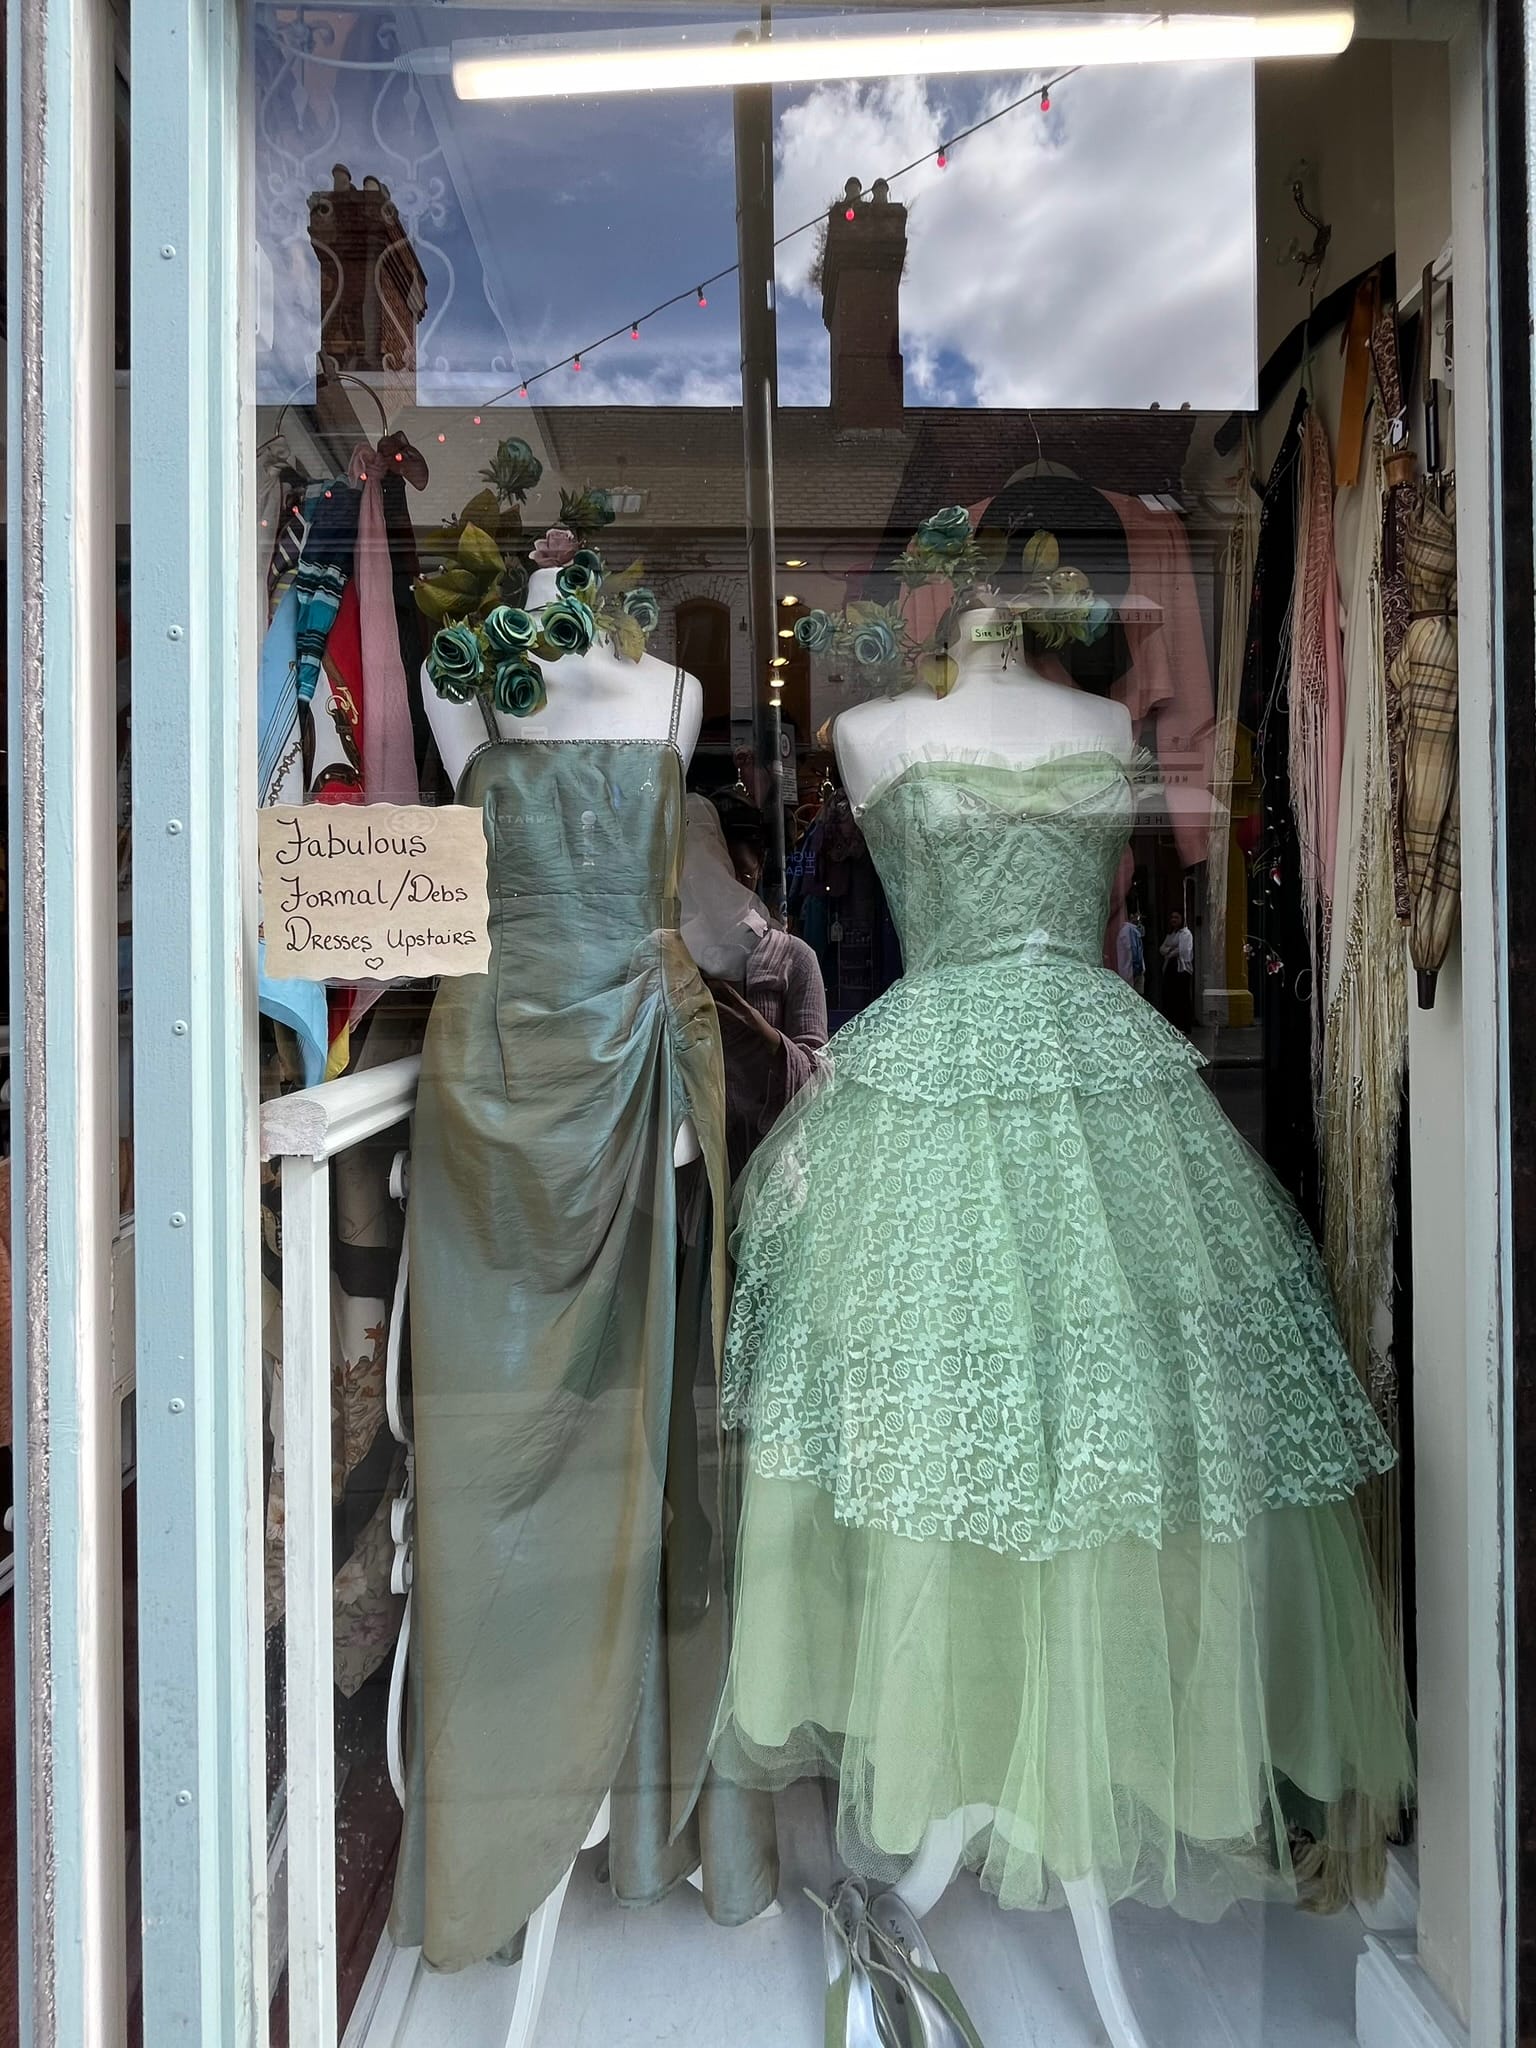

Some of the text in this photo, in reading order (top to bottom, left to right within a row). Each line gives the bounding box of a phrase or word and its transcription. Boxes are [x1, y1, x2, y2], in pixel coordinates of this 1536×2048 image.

[276, 818, 427, 865] Fabulous
[285, 916, 477, 956] Dresses Upstairs
